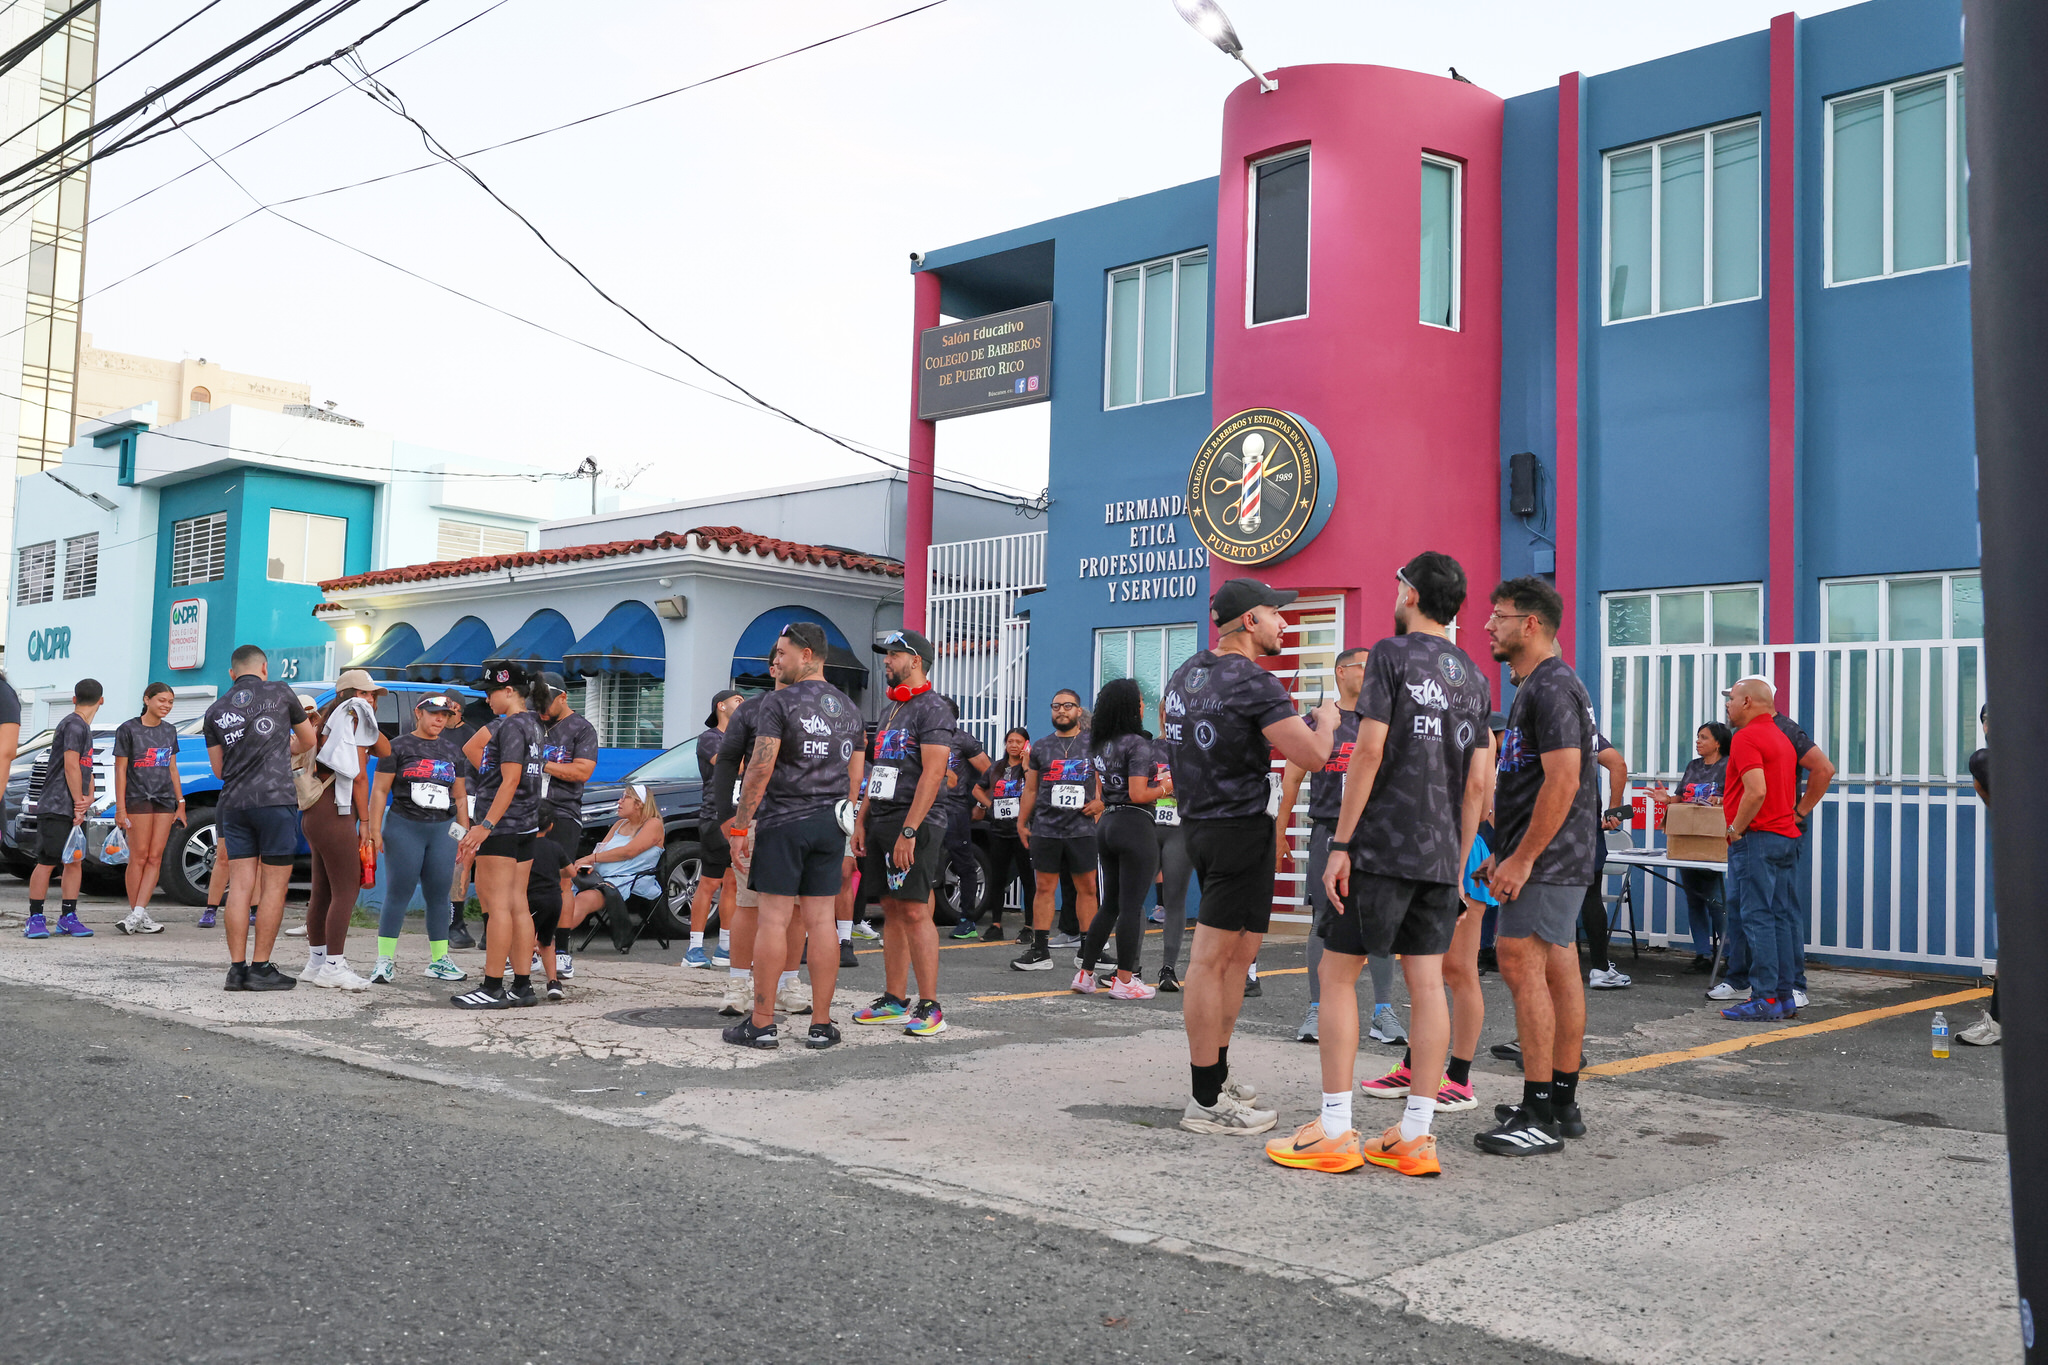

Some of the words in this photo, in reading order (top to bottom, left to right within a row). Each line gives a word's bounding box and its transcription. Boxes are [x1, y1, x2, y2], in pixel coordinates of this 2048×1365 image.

[942, 331, 970, 347] Salón
[973, 321, 1024, 341] Educativo
[925, 351, 969, 370] COLEGIO
[971, 348, 984, 360] DE
[987, 336, 1041, 358] BARBEROS
[939, 373, 953, 386] DE
[955, 365, 995, 383] PUERTO
[998, 359, 1024, 375] RICO
[1192, 459, 1207, 500] COLEGIO
[1204, 446, 1214, 460] DE
[1211, 418, 1247, 448] BARBEROS
[1247, 416, 1253, 424] Y
[1254, 415, 1291, 434] ESTILISTAS
[1289, 430, 1301, 443] EN
[1296, 441, 1312, 485] BARBERÍA
[1275, 473, 1293, 482] 1989
[1130, 522, 1176, 548] ETICA
[1206, 532, 1257, 558] PUERTO
[1260, 528, 1292, 555] RICO
[1108, 581, 1118, 603] Y
[1121, 575, 1197, 603] SERVICIO
[280, 658, 298, 679] 25
[145, 747, 169, 761] 5K
[803, 740, 829, 755] EME
[417, 759, 450, 774] 5K
[1049, 759, 1083, 775] 5K
[402, 770, 432, 779] FADE
[871, 780, 882, 794] 28
[428, 794, 435, 804] 7
[1059, 795, 1077, 806] 121
[1000, 808, 1011, 817] 96
